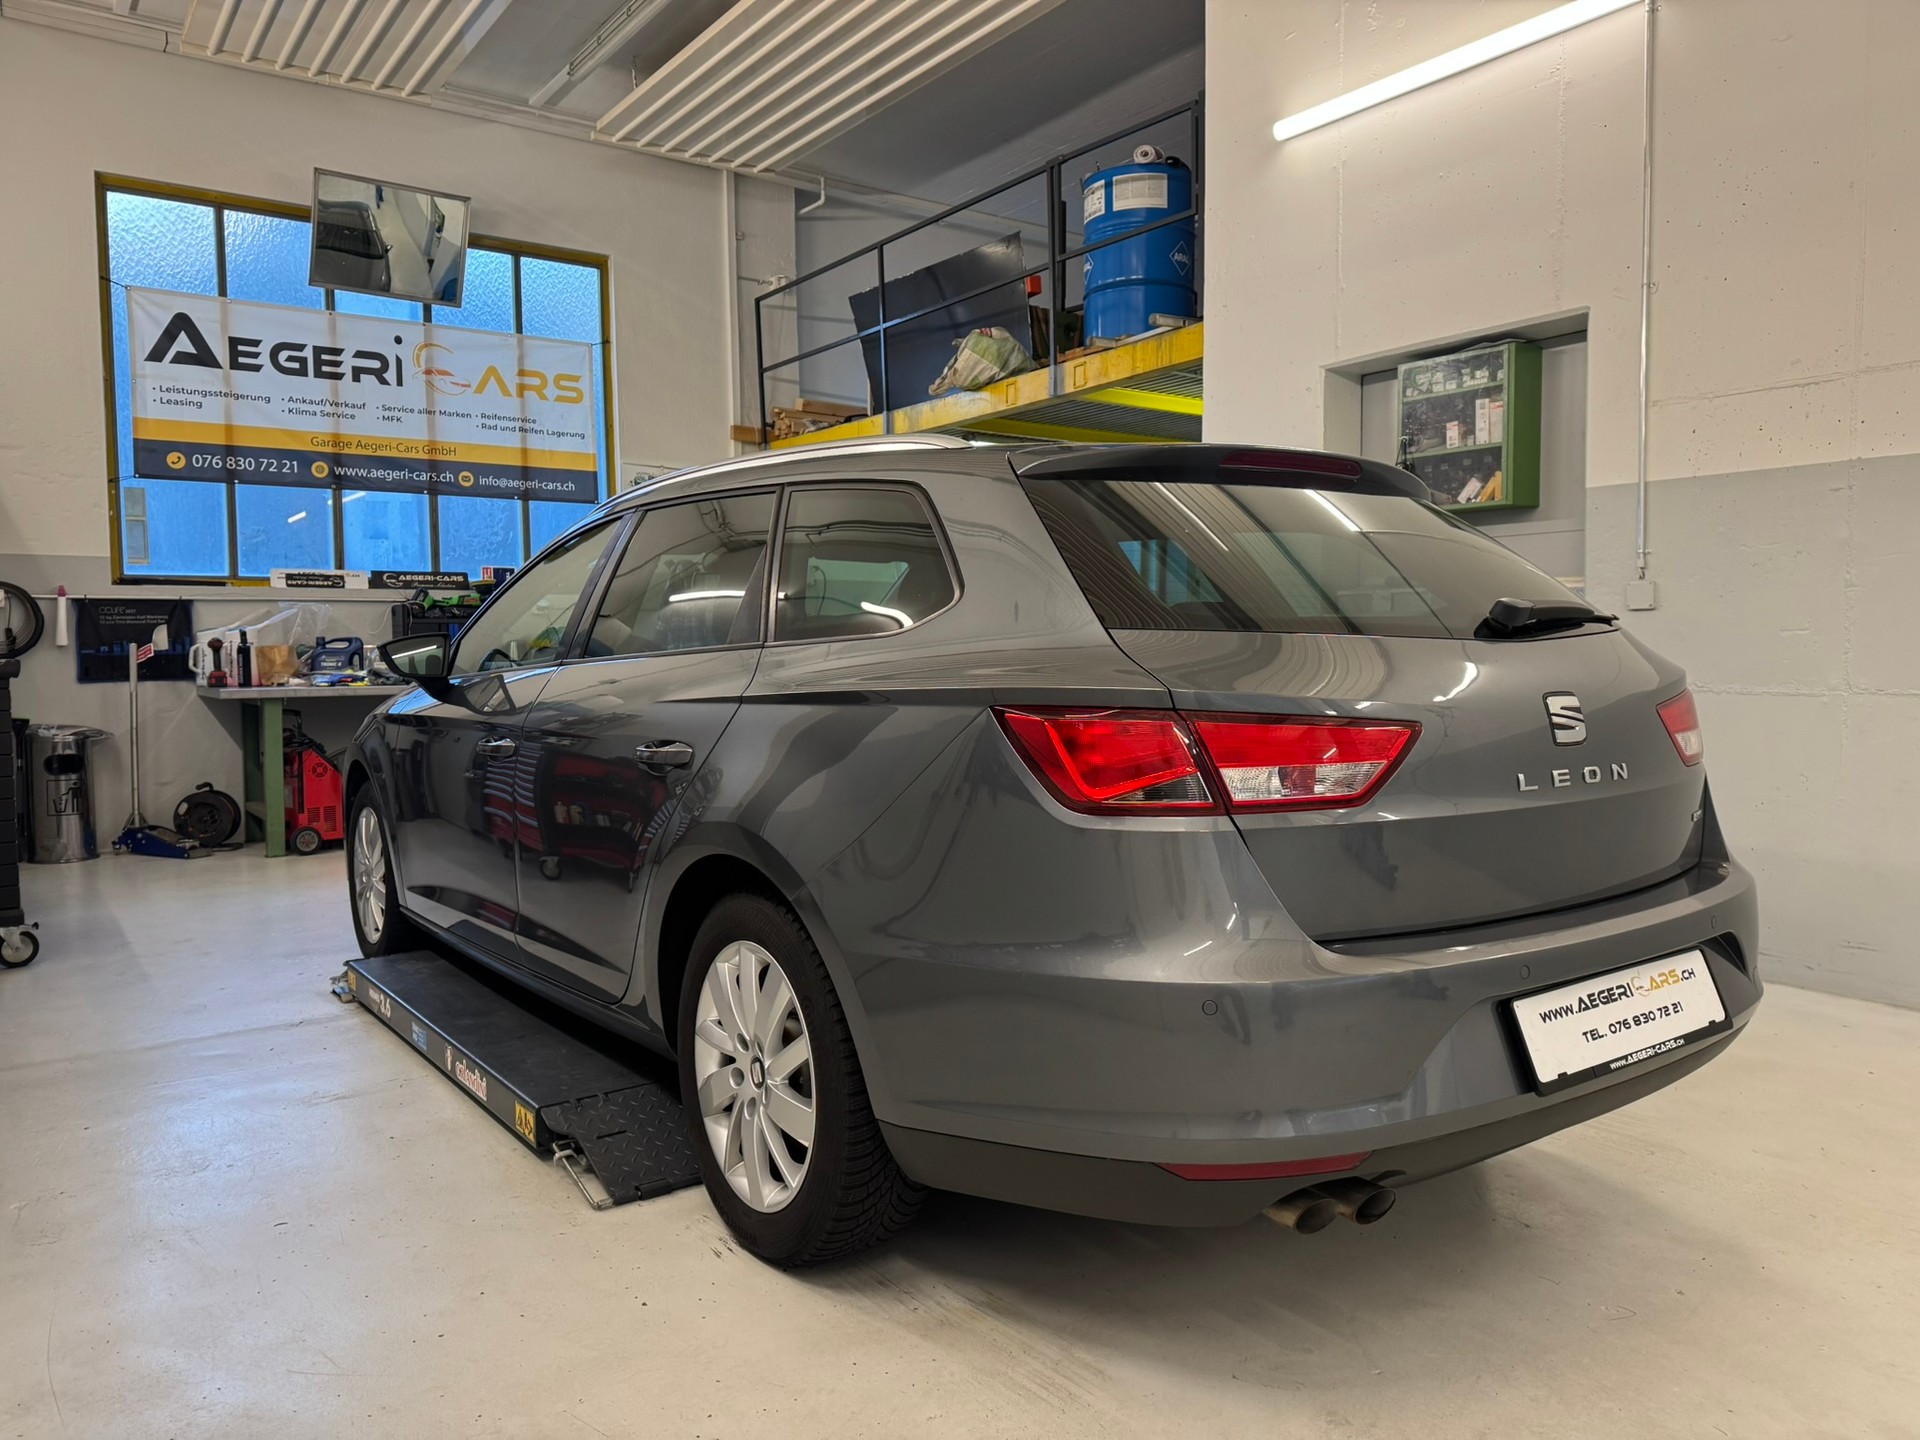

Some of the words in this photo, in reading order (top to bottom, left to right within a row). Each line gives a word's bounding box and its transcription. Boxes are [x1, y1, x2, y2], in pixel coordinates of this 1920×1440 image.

[159, 385, 271, 404] Leistungssteigerung
[287, 395, 366, 411] Ankauf/Verkauf
[159, 397, 203, 410] Leasing
[381, 404, 415, 414] Service
[417, 407, 437, 417] aller
[439, 409, 472, 419] Marken
[287, 408, 317, 417] Klima
[319, 410, 356, 420] Service
[382, 415, 403, 424] MFK
[480, 412, 537, 425] Reifenservice
[481, 423, 498, 432] Rad
[500, 424, 517, 433] und
[519, 426, 545, 436] Reifen
[546, 428, 586, 440] Lagerung
[310, 436, 353, 451] Garage
[355, 440, 420, 455] Aegeri-Cars
[422, 441, 457, 457] GmbH
[192, 453, 222, 469] 076
[226, 456, 255, 471] 830
[258, 458, 278, 472] 72
[281, 459, 298, 473] 21
[334, 465, 454, 483] www.aegeri-cars.ch
[479, 475, 576, 492] info@aegeri-cars.ch
[398, 574, 464, 582] AEGERI-CARS
[1517, 762, 1629, 792] LEON
[1582, 1028, 1608, 1043] TEL.
[1608, 1019, 1632, 1035] 076
[1633, 1010, 1657, 1027] 830
[1658, 1005, 1671, 1020] 72
[1671, 1001, 1684, 1014] 21
